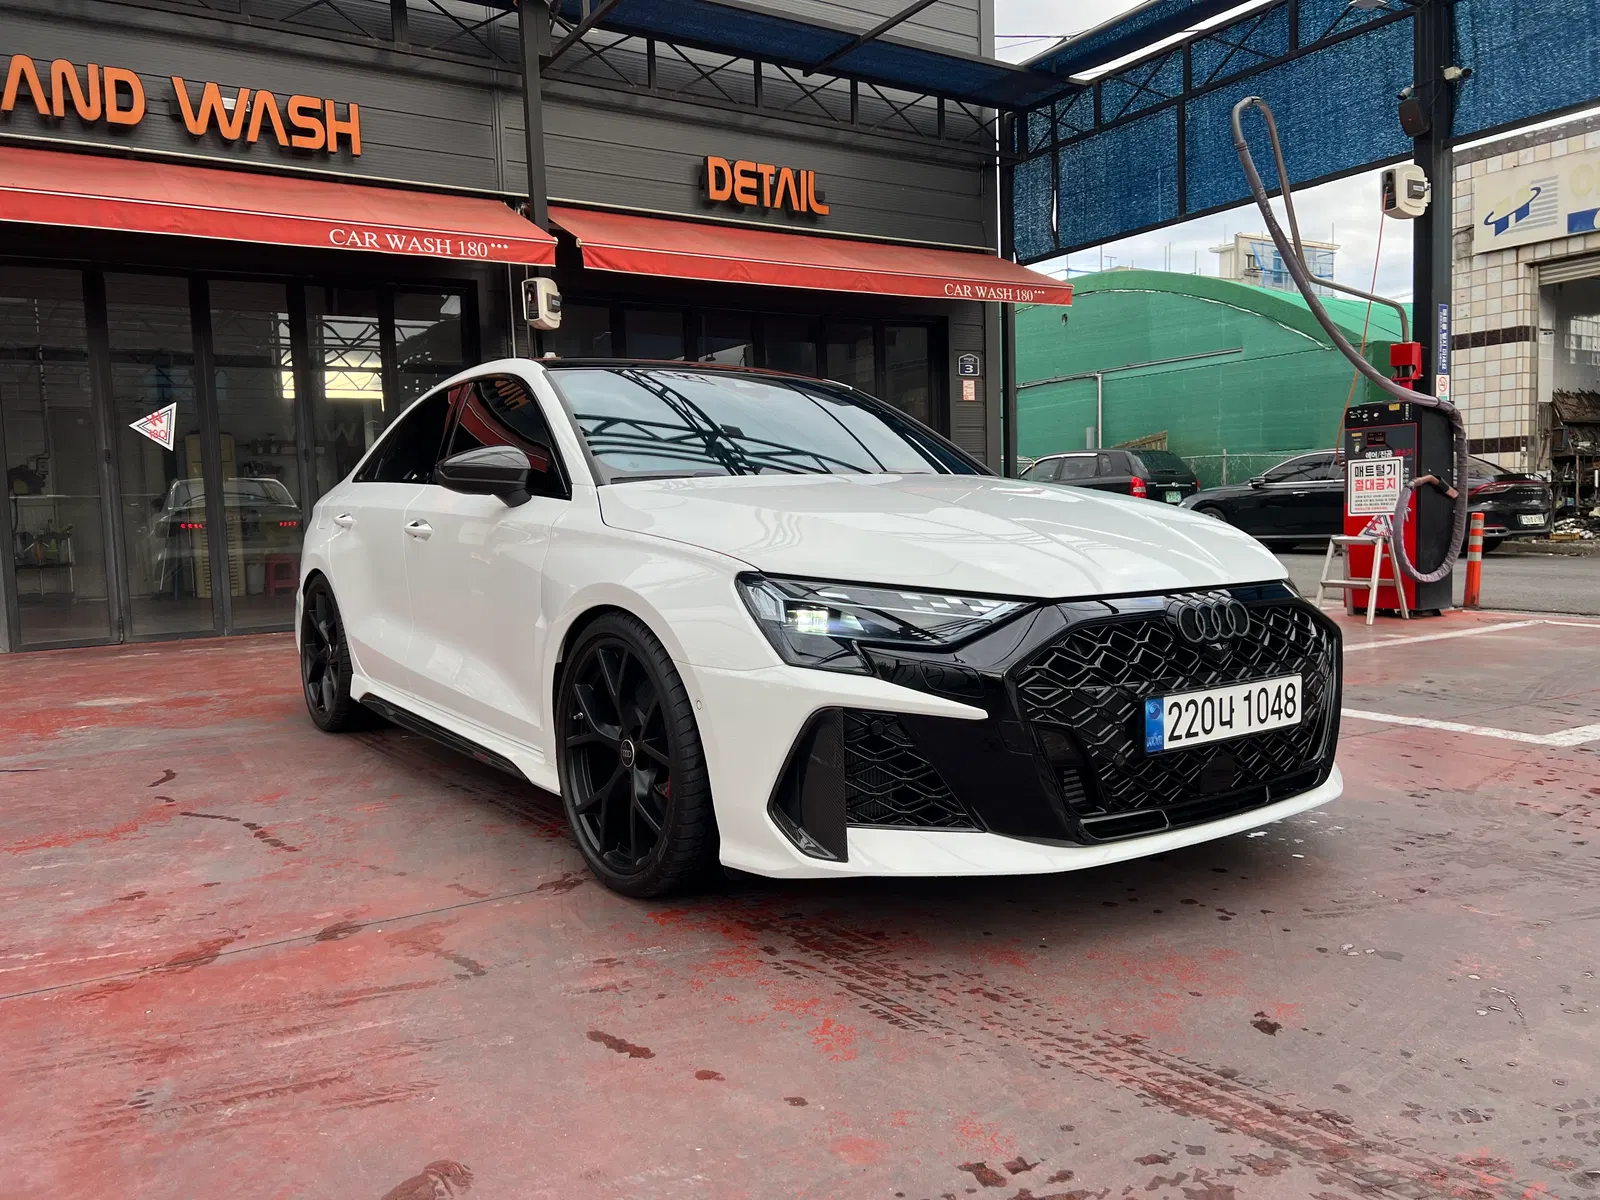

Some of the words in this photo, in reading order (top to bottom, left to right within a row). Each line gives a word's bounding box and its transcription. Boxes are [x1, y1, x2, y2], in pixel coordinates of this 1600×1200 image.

[1, 53, 146, 126] AND
[170, 75, 362, 157] WASH
[707, 155, 830, 216] DETAIL
[329, 228, 380, 249] CAR
[384, 233, 452, 255] WASH
[944, 283, 972, 297] CAR
[975, 285, 1013, 301] WASH
[964, 364, 974, 373] 3
[1354, 463, 1396, 478] 매트털기
[1355, 477, 1396, 492] 절대금지
[1168, 696, 1235, 742] 220나
[1243, 682, 1297, 727] 1048
